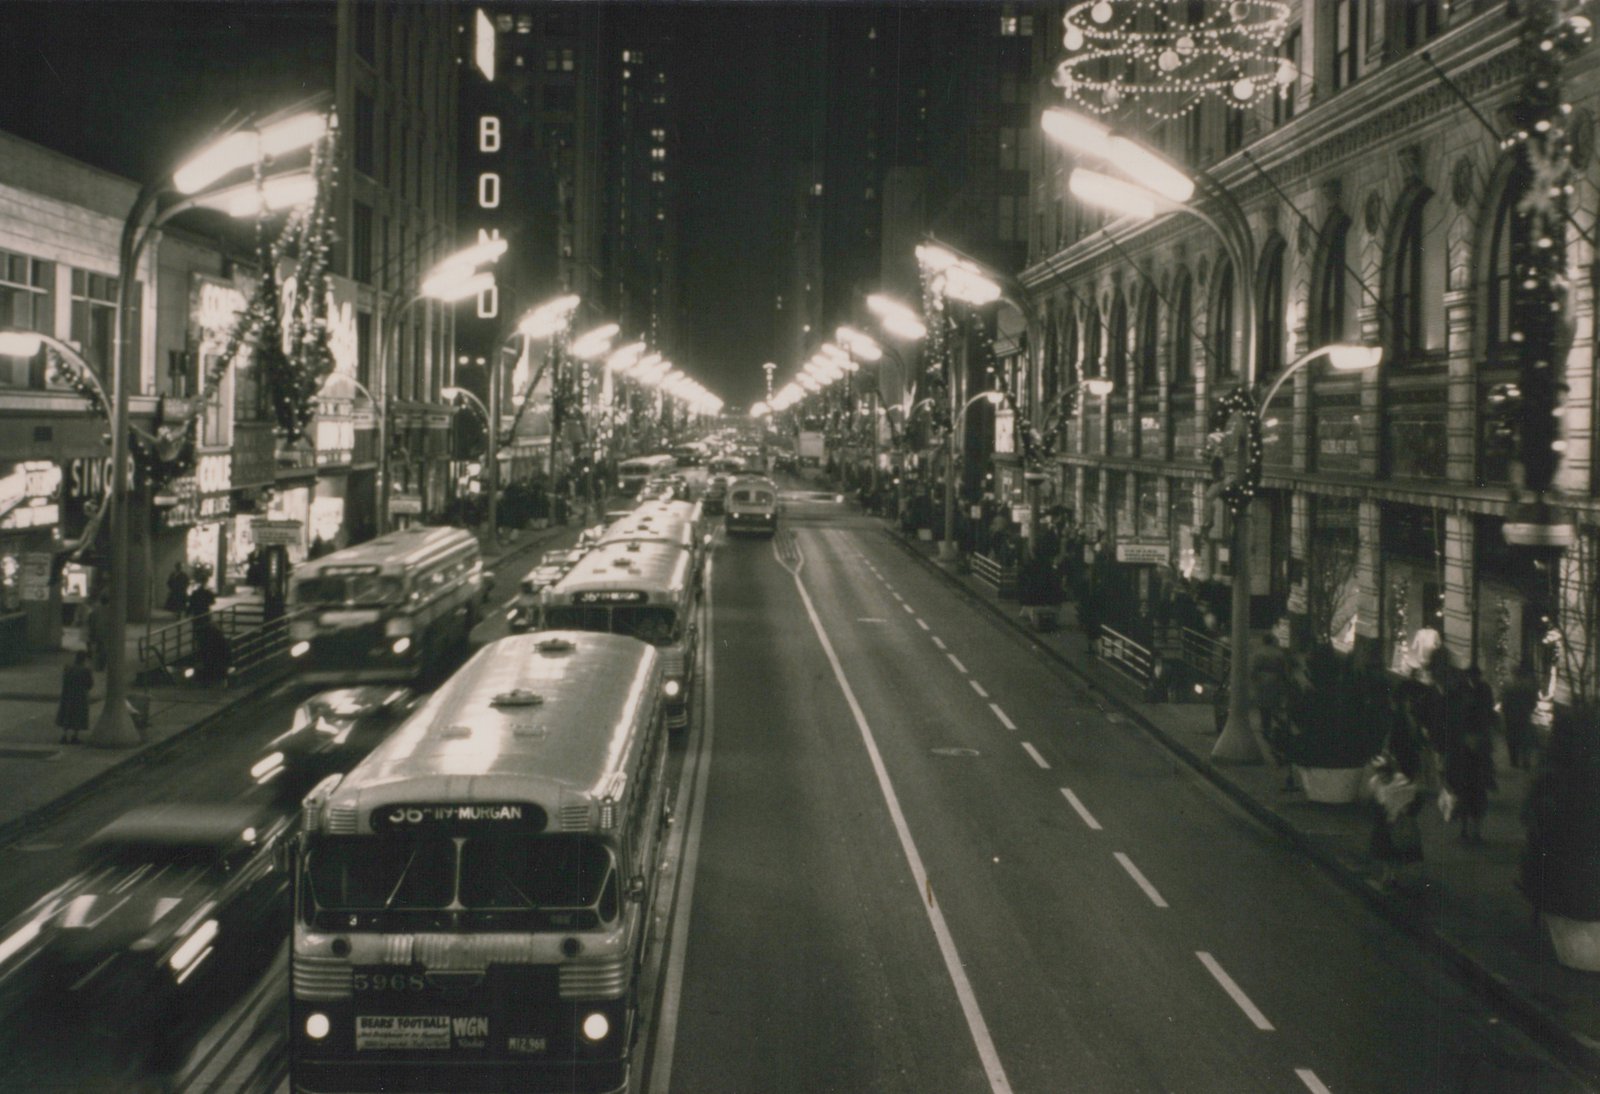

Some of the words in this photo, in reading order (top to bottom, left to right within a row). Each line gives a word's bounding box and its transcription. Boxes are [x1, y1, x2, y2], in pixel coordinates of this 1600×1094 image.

[71, 454, 136, 498] SINGR
[353, 973, 425, 991] 5968
[397, 1017, 449, 1029] FOOTBALL
[452, 1016, 489, 1037] WGN
